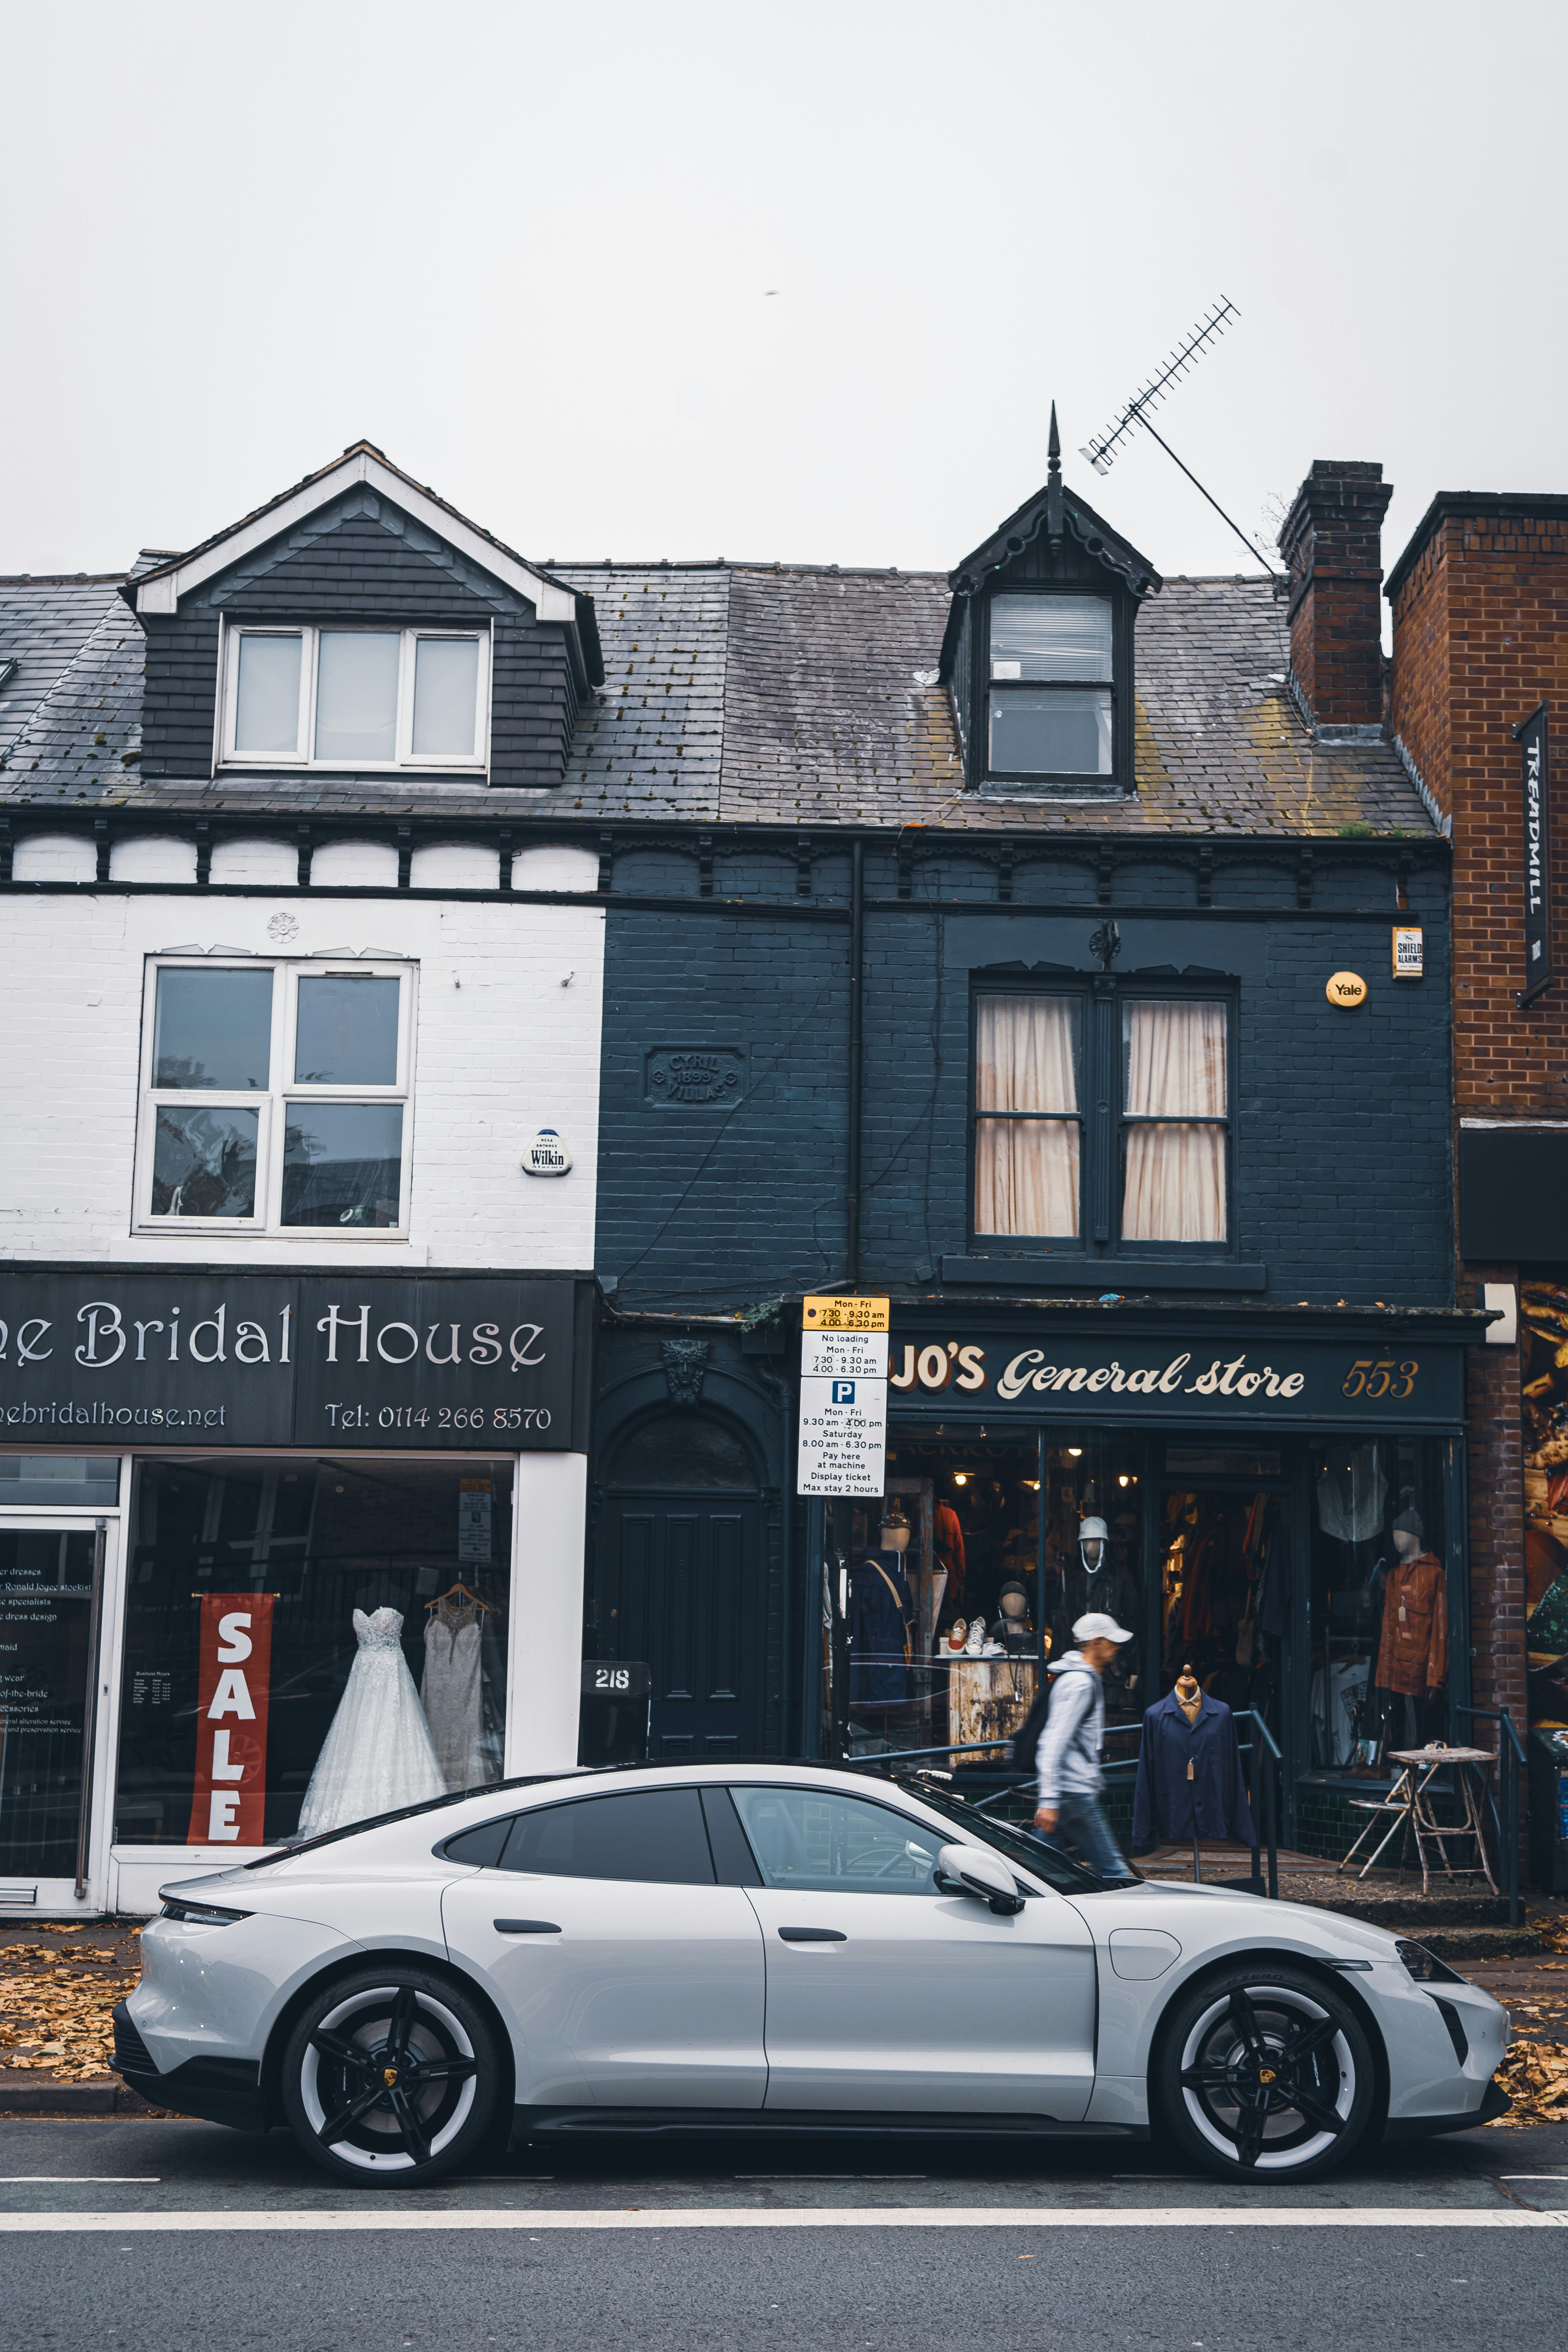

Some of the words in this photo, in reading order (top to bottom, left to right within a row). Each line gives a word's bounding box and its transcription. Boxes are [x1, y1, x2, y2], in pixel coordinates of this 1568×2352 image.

[1527, 736, 1541, 915] TREADMILL
[1398, 943, 1422, 953] SHIELD
[1398, 955, 1422, 963] ALARMS
[1335, 984, 1361, 995] Yale
[669, 1055, 720, 1073] CYRIL
[667, 1084, 727, 1102] VILLAS
[531, 1150, 564, 1165] Wilkin
[75, 1302, 291, 1367] Bridal
[317, 1305, 546, 1372] House
[837, 1335, 868, 1343] loading
[889, 1341, 985, 1389] JO'S
[997, 1349, 1191, 1400] General
[1184, 1355, 1304, 1398] store
[1343, 1360, 1419, 1398] 553
[837, 1383, 852, 1402] P
[325, 1403, 369, 1430] Tel:
[378, 1407, 430, 1428] 0114
[438, 1408, 484, 1428] 266
[493, 1408, 551, 1429] 8570
[823, 1431, 862, 1439] Saturday
[823, 1452, 838, 1460] Pay
[811, 1472, 842, 1481] Display
[5, 1582, 33, 1591] Ronald
[36, 1583, 58, 1592] Joyce
[8, 1598, 51, 1606] specialists
[30, 1613, 57, 1622] design
[207, 1612, 257, 1841] SALE
